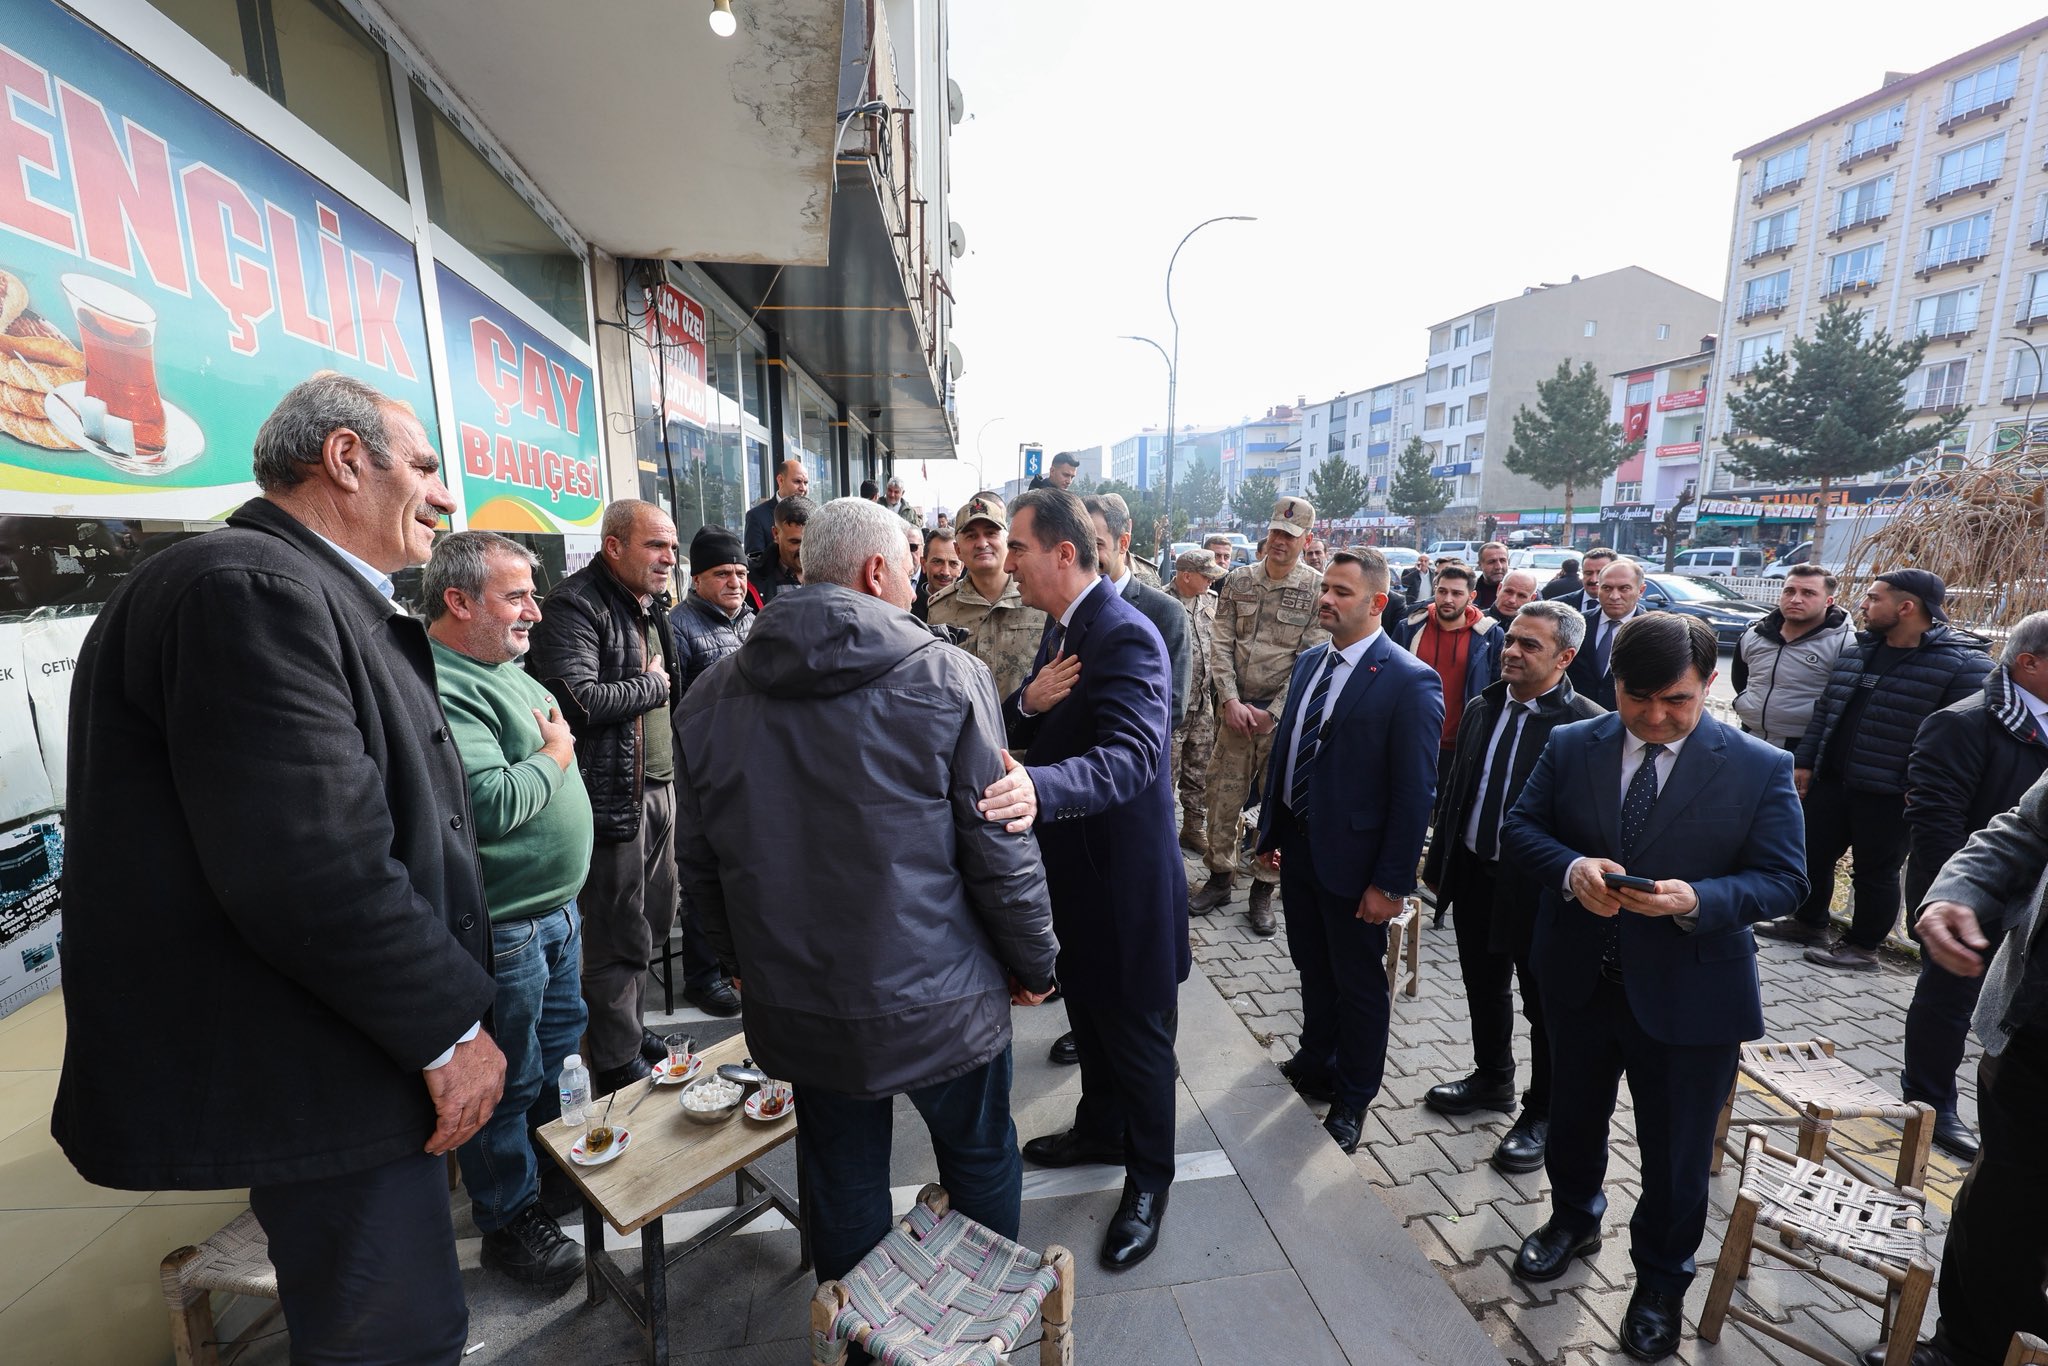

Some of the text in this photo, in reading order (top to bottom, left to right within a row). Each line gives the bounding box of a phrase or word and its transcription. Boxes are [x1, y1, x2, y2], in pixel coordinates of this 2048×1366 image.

[681, 301, 705, 346] ÖZEL
[470, 315, 584, 437] ÇAY
[460, 420, 601, 503] BAHÇESİ
[22, 884, 58, 909] UMRE
[30, 897, 54, 914] KUDÜS
